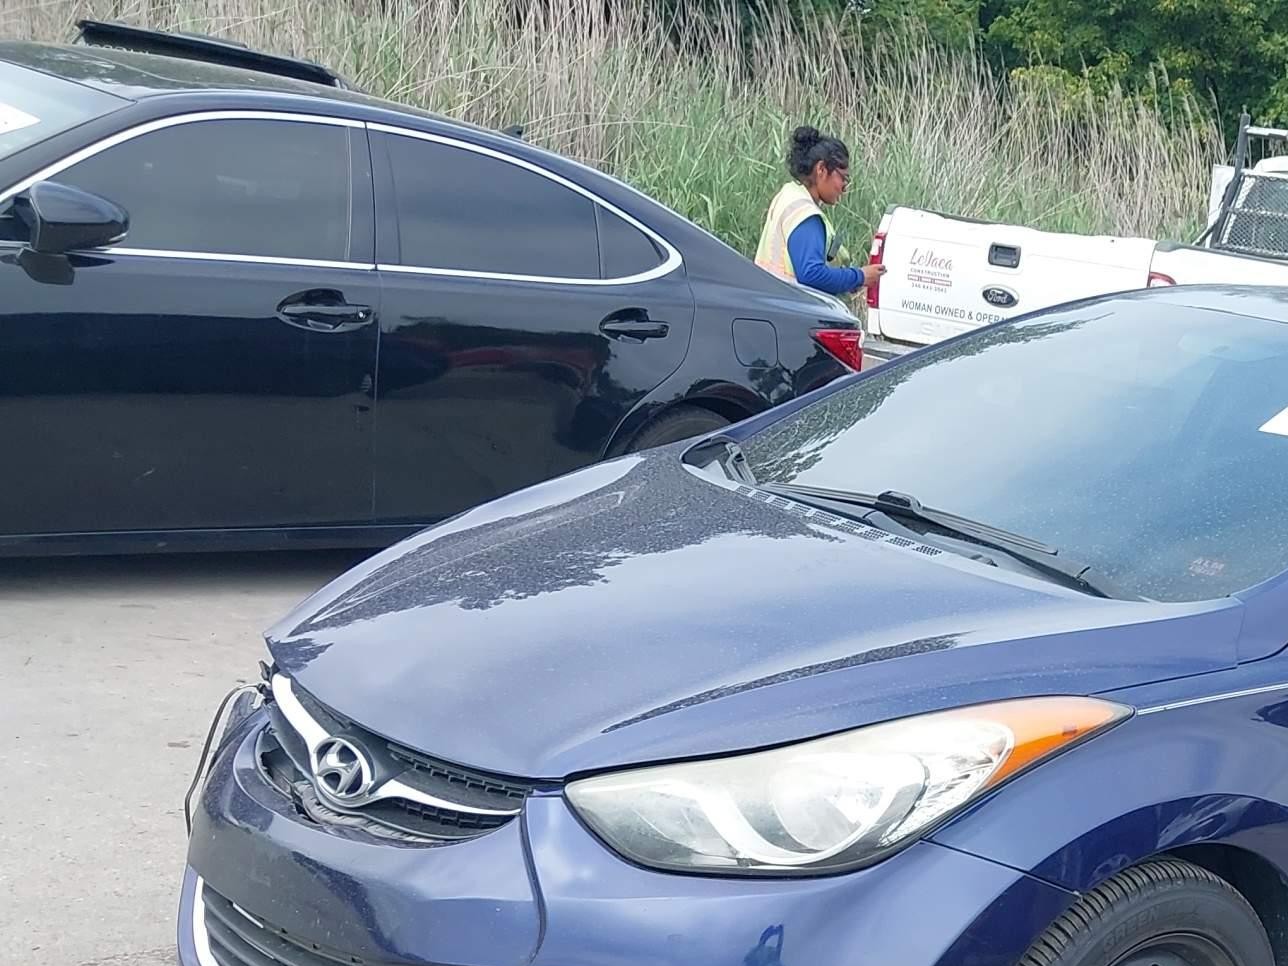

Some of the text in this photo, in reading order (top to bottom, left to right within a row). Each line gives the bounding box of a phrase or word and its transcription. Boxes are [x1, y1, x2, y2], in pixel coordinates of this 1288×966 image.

[987, 289, 1008, 304] Ford
[901, 299, 932, 313] WOMAN
[934, 305, 965, 319] OWNED
[967, 311, 974, 321] &
